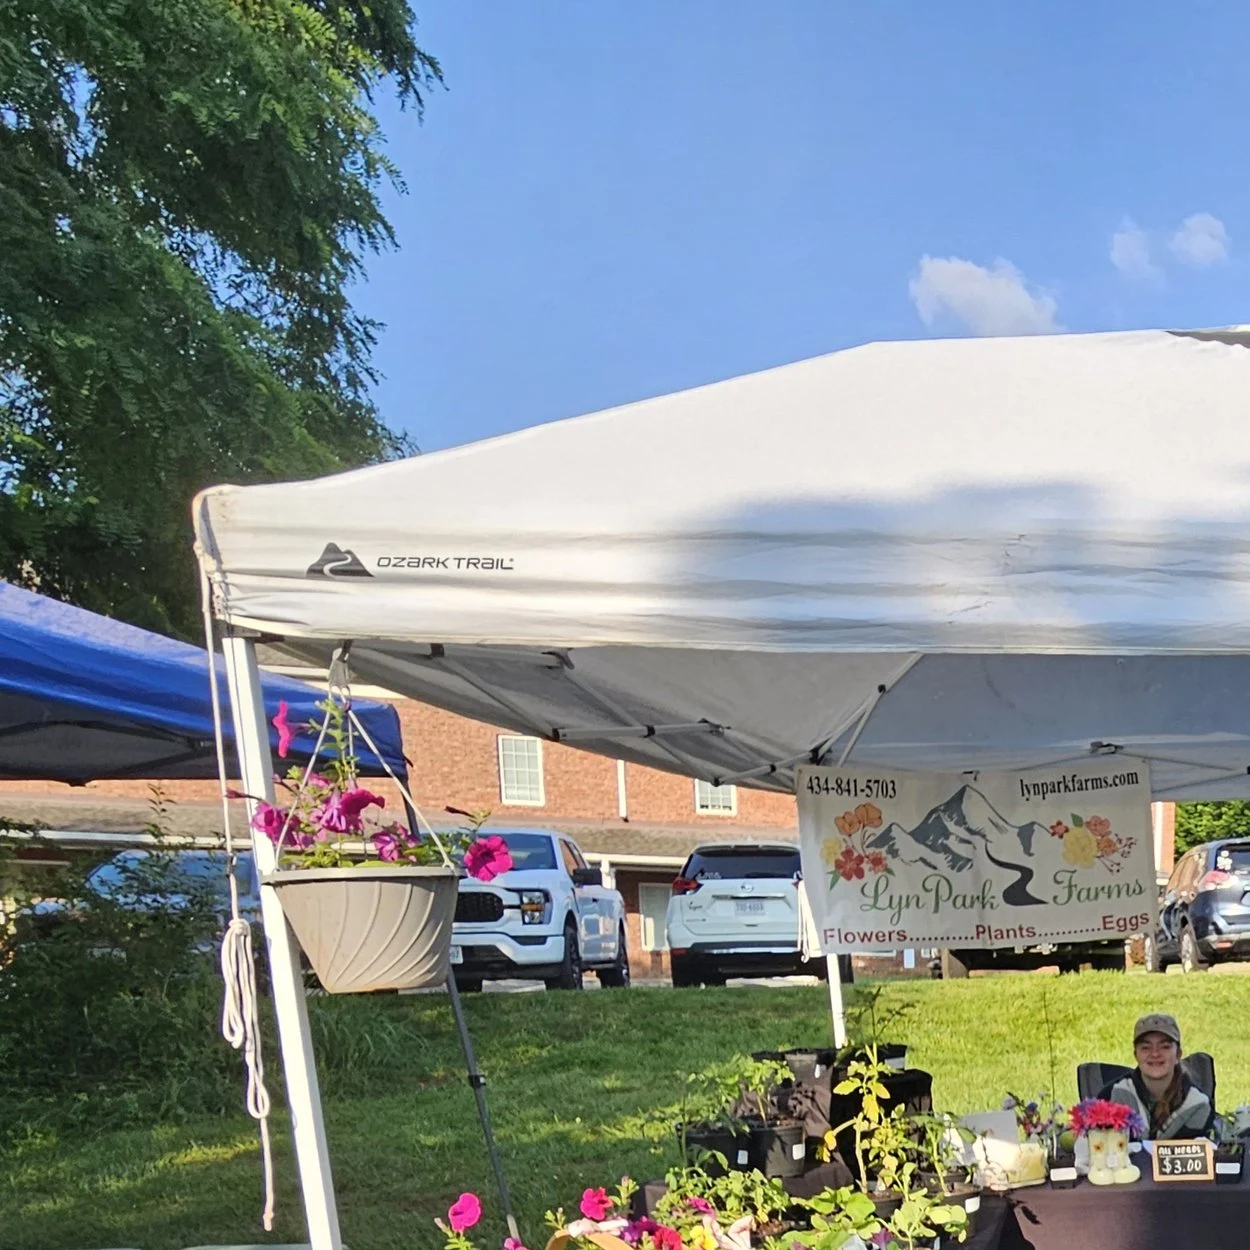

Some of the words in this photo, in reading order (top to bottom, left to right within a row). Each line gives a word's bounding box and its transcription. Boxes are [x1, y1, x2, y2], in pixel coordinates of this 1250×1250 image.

[806, 776, 897, 800] 434-841-5703
[1020, 771, 1139, 801] lynparkfarms.com
[1053, 869, 1146, 906] Farms
[1161, 1157, 1202, 1175] $3.00
